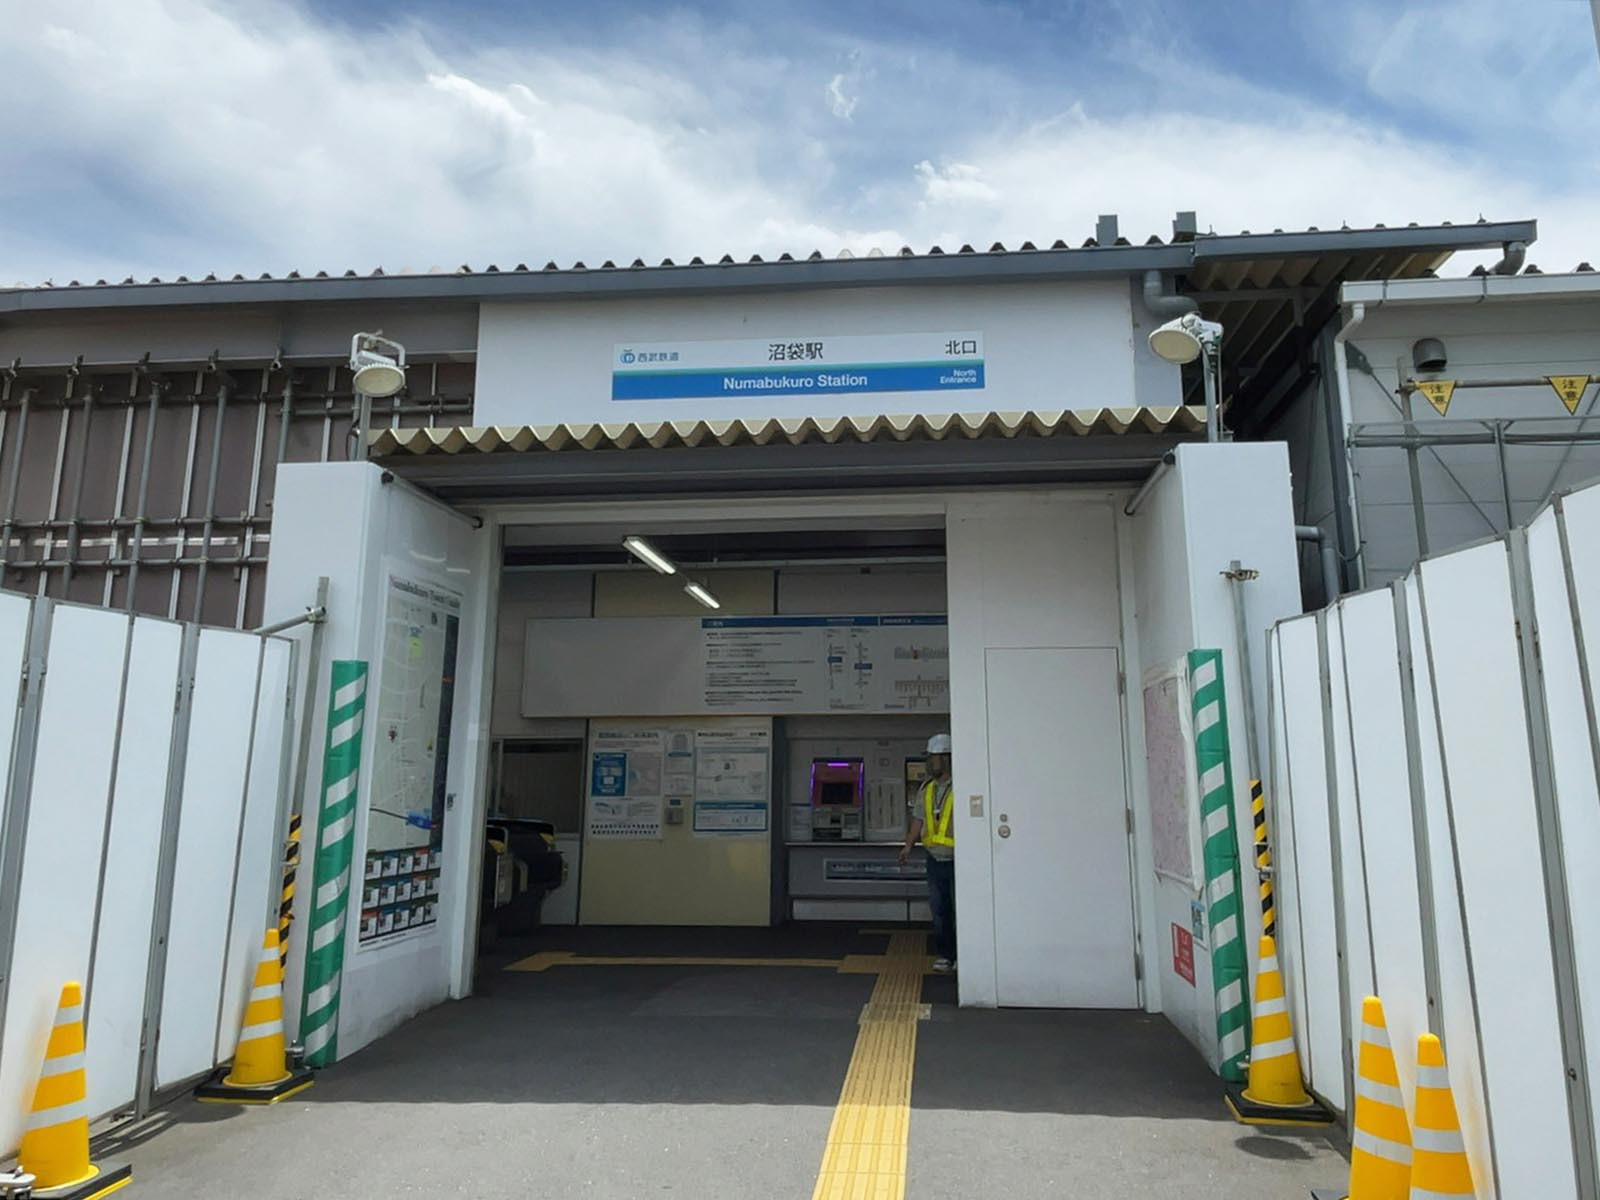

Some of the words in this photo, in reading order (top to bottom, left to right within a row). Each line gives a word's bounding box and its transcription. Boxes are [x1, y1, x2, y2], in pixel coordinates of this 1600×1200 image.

[768, 342, 823, 361] 沼袋駅
[945, 340, 976, 355] 北口
[638, 352, 679, 362] 西武鉄道
[953, 369, 976, 377] North
[723, 375, 813, 390] Numabukuro
[817, 374, 868, 387] Station
[940, 376, 977, 384] Entrance
